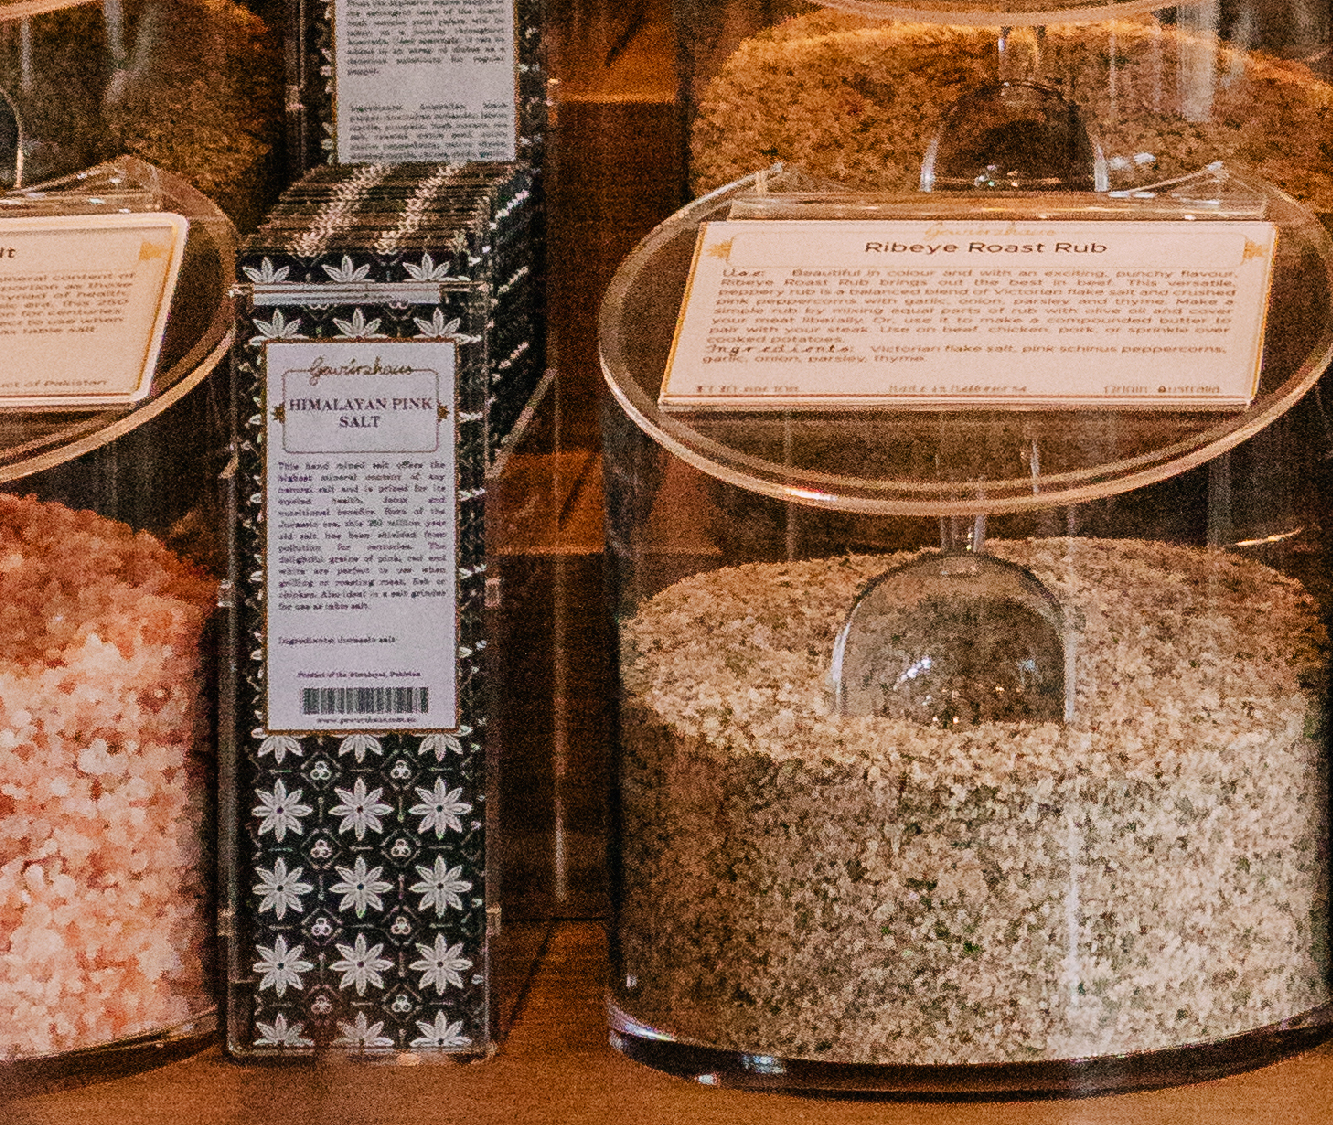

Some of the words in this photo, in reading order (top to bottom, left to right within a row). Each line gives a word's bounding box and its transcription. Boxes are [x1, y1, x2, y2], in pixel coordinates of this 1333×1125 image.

[865, 241, 958, 255] Ribeye
[968, 242, 1045, 253] Roast
[1054, 242, 1108, 253] Rub
[792, 269, 860, 277] Beautiful
[867, 269, 880, 277] in
[943, 269, 972, 277] and
[1116, 270, 1173, 279] punchy
[721, 279, 774, 287] Ribeye
[880, 279, 927, 287] brings
[719, 289, 784, 297] peppery
[870, 345, 940, 353] Victorian
[945, 345, 978, 353] flake
[1022, 345, 1054, 354] pink
[1060, 345, 1117, 353] schinus
[289, 398, 387, 412] HIMALAYAN
[391, 396, 434, 410] PINK
[339, 414, 381, 429] SALT
